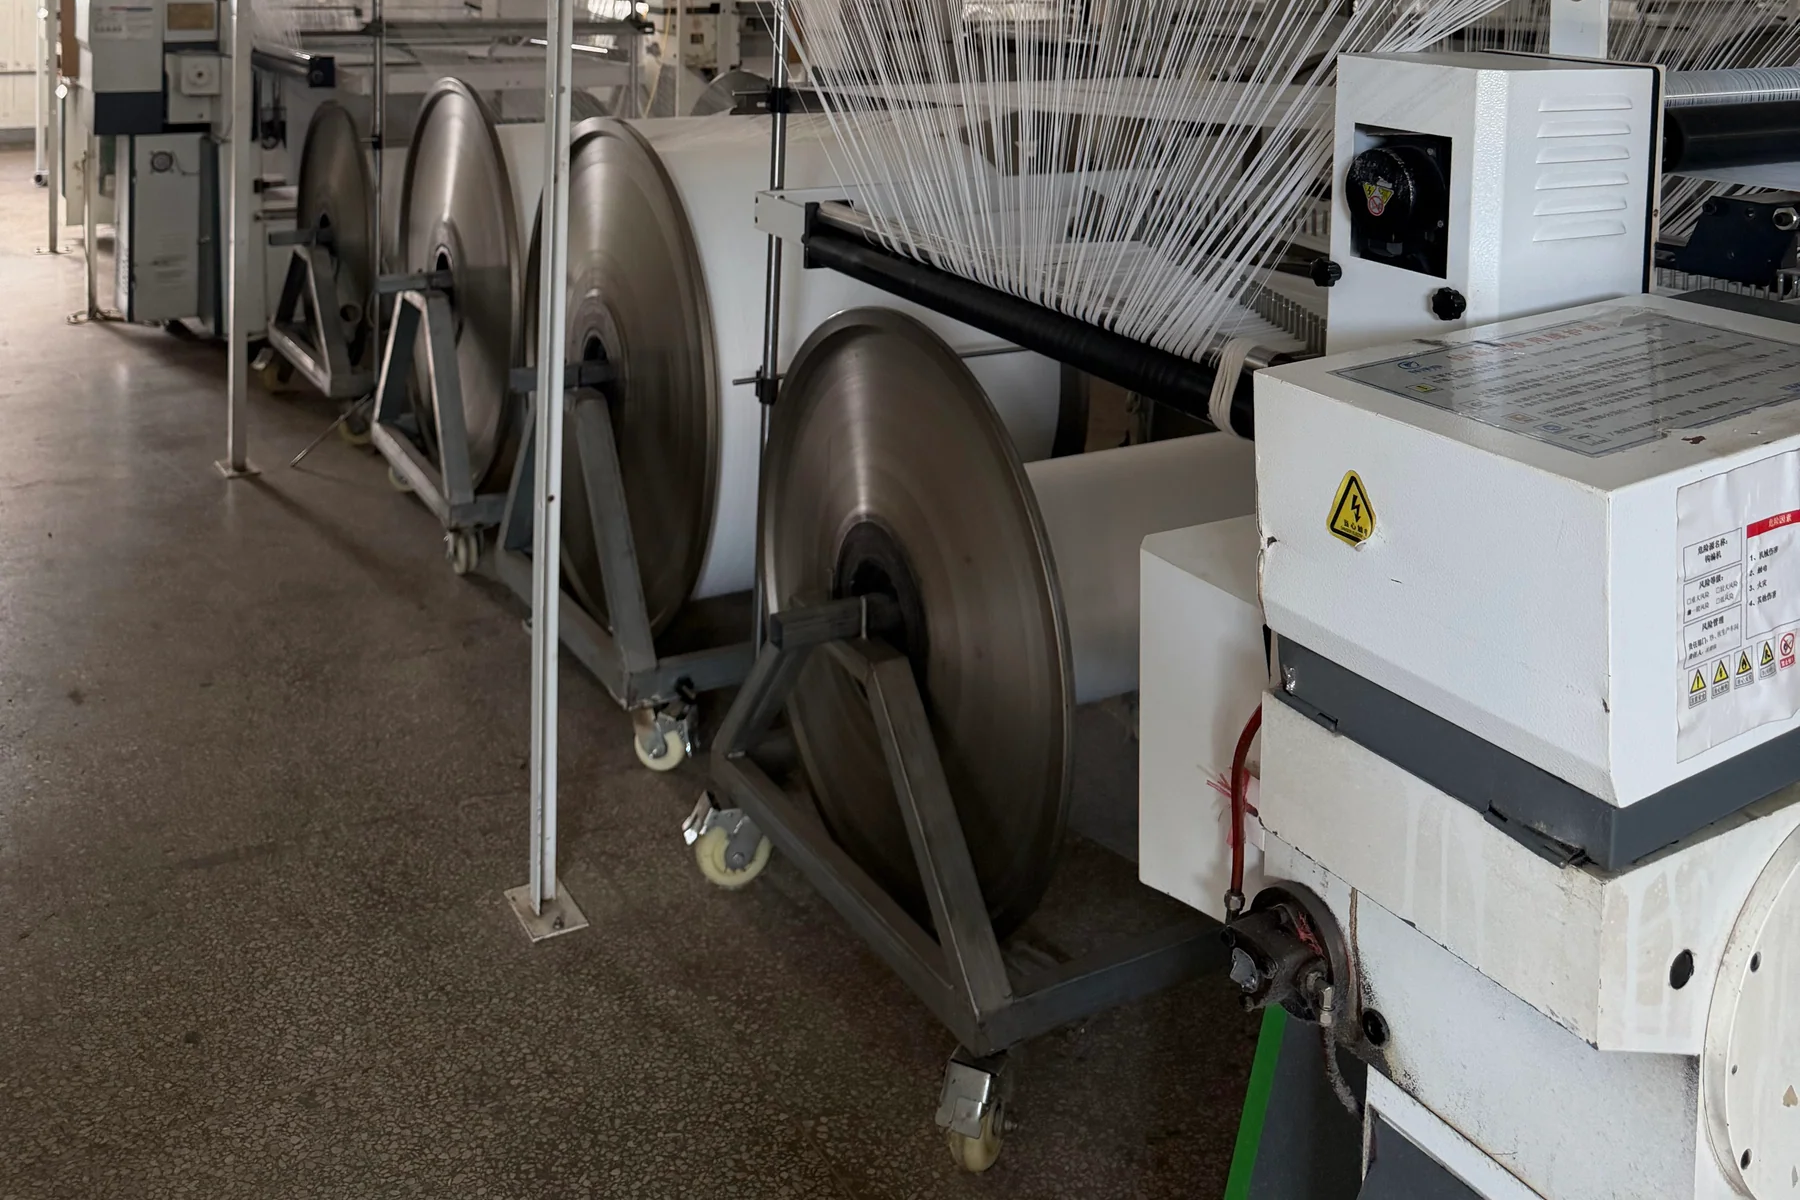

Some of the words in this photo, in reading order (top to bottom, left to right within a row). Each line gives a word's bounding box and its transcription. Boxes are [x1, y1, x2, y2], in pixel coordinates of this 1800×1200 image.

[1768, 513, 1792, 528] 危险因素
[1701, 615, 1725, 632] 风险管理
